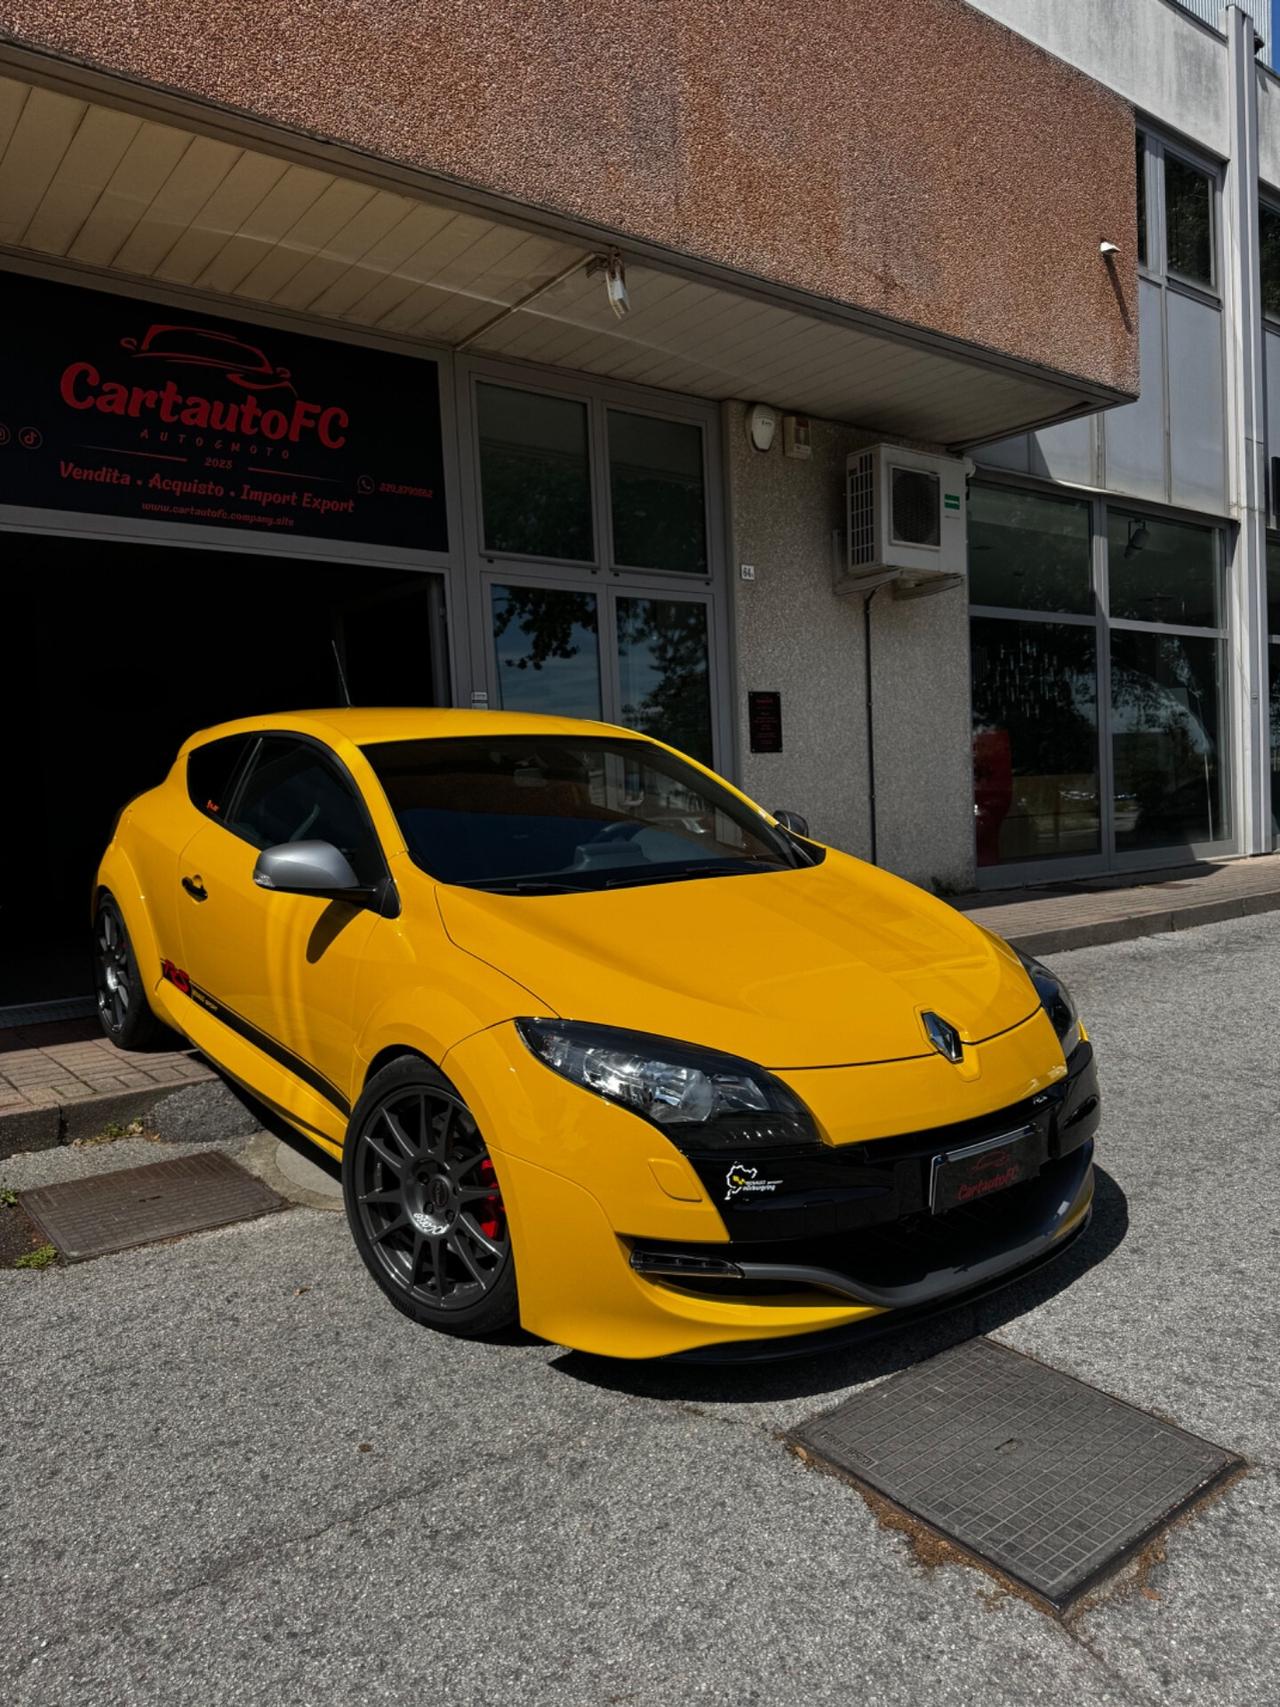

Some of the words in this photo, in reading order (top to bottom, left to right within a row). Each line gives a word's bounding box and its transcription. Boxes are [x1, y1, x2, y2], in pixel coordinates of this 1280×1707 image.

[60, 362, 349, 449] CartautoFC
[59, 461, 131, 486] Vendita
[148, 473, 224, 499] Acquisto
[241, 485, 297, 507] Import
[302, 494, 354, 514] Export
